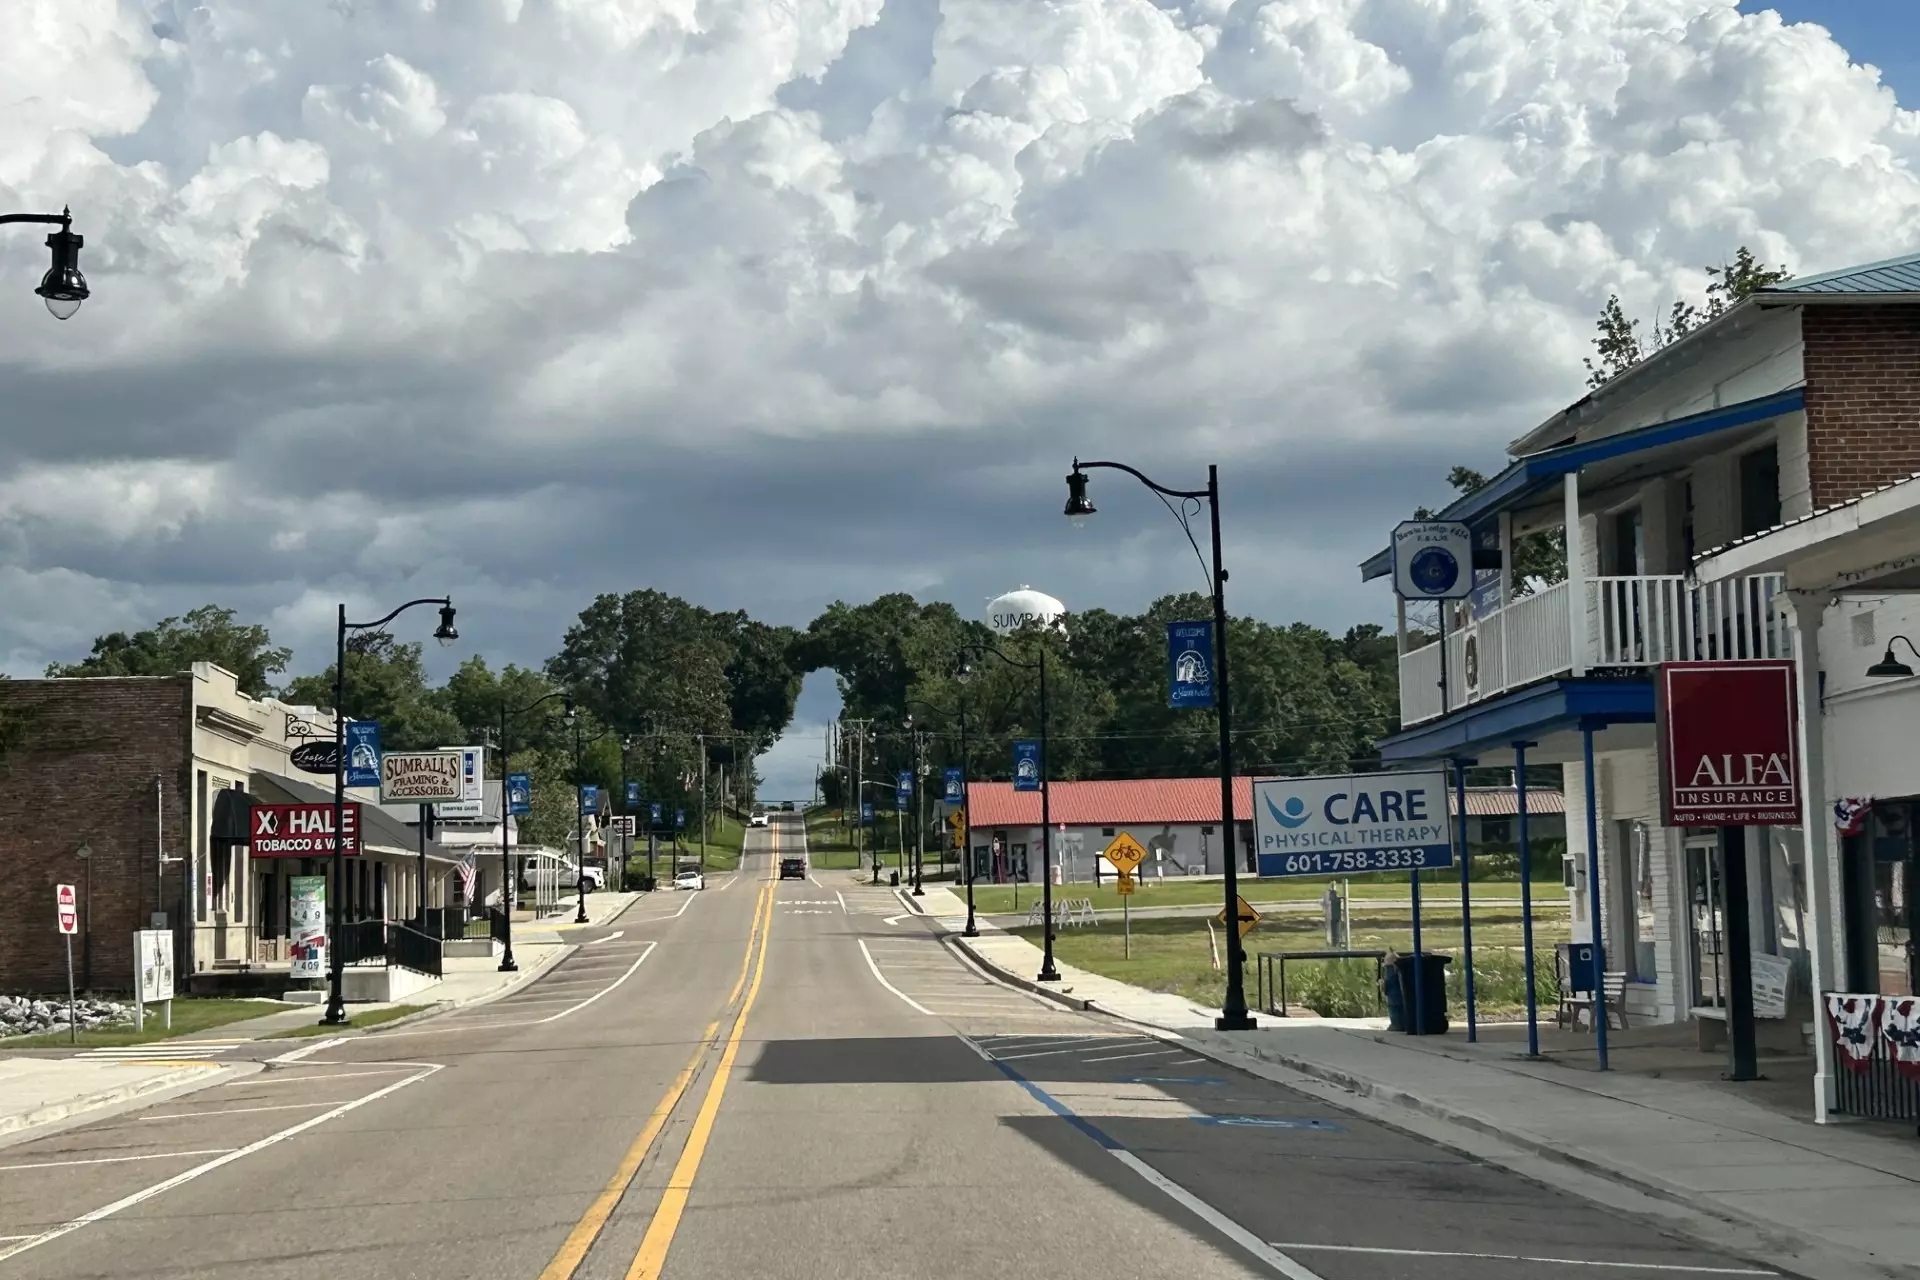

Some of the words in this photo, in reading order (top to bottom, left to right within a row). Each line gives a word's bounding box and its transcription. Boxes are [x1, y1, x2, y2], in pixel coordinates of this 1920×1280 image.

[386, 757, 457, 781] SUMRALL'S
[1689, 752, 1791, 786] ALFA
[389, 786, 454, 797] ACCESSORIES
[393, 774, 439, 788] FRAMING
[441, 777, 449, 786] &
[1323, 789, 1428, 825] CARE
[1680, 791, 1788, 804] INSURANCE
[289, 809, 355, 834] HALE
[256, 839, 311, 851] TOBACCO
[314, 839, 322, 850] &
[1264, 831, 1354, 848] PHYSICAL
[1357, 825, 1443, 843] THERAPY
[1285, 848, 1427, 872] 601-758-3333
